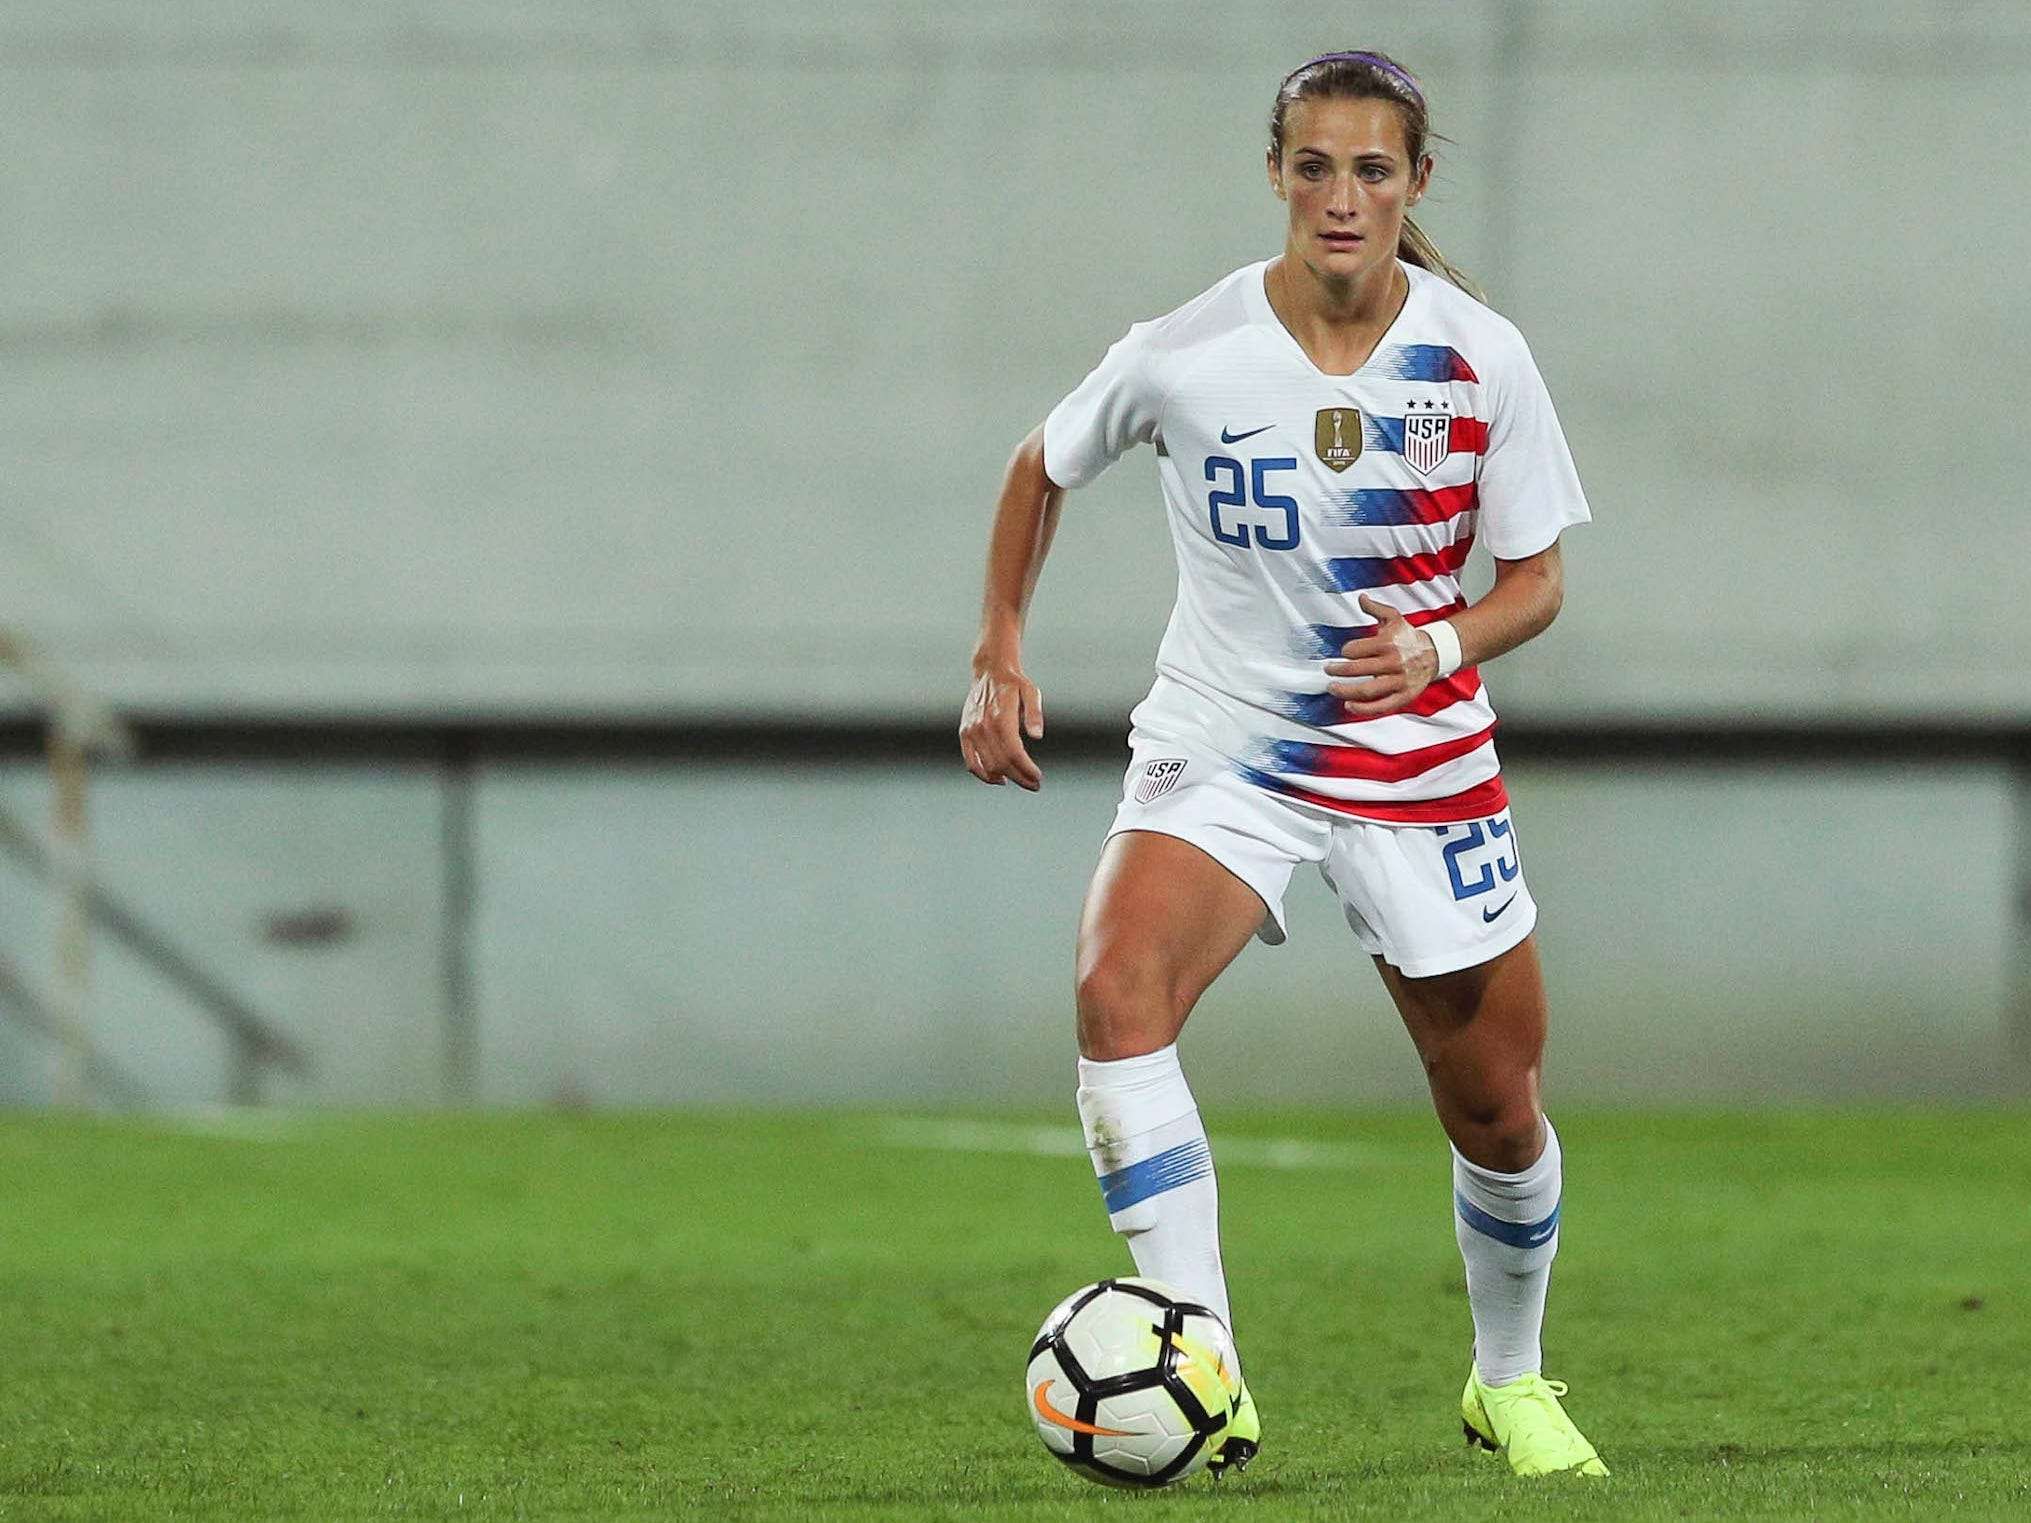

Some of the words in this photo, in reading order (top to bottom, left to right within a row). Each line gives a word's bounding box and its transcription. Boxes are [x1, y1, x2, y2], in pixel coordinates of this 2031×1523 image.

[1408, 418, 1446, 440] USA
[1204, 455, 1300, 551] 25
[1146, 762, 1182, 778] USA
